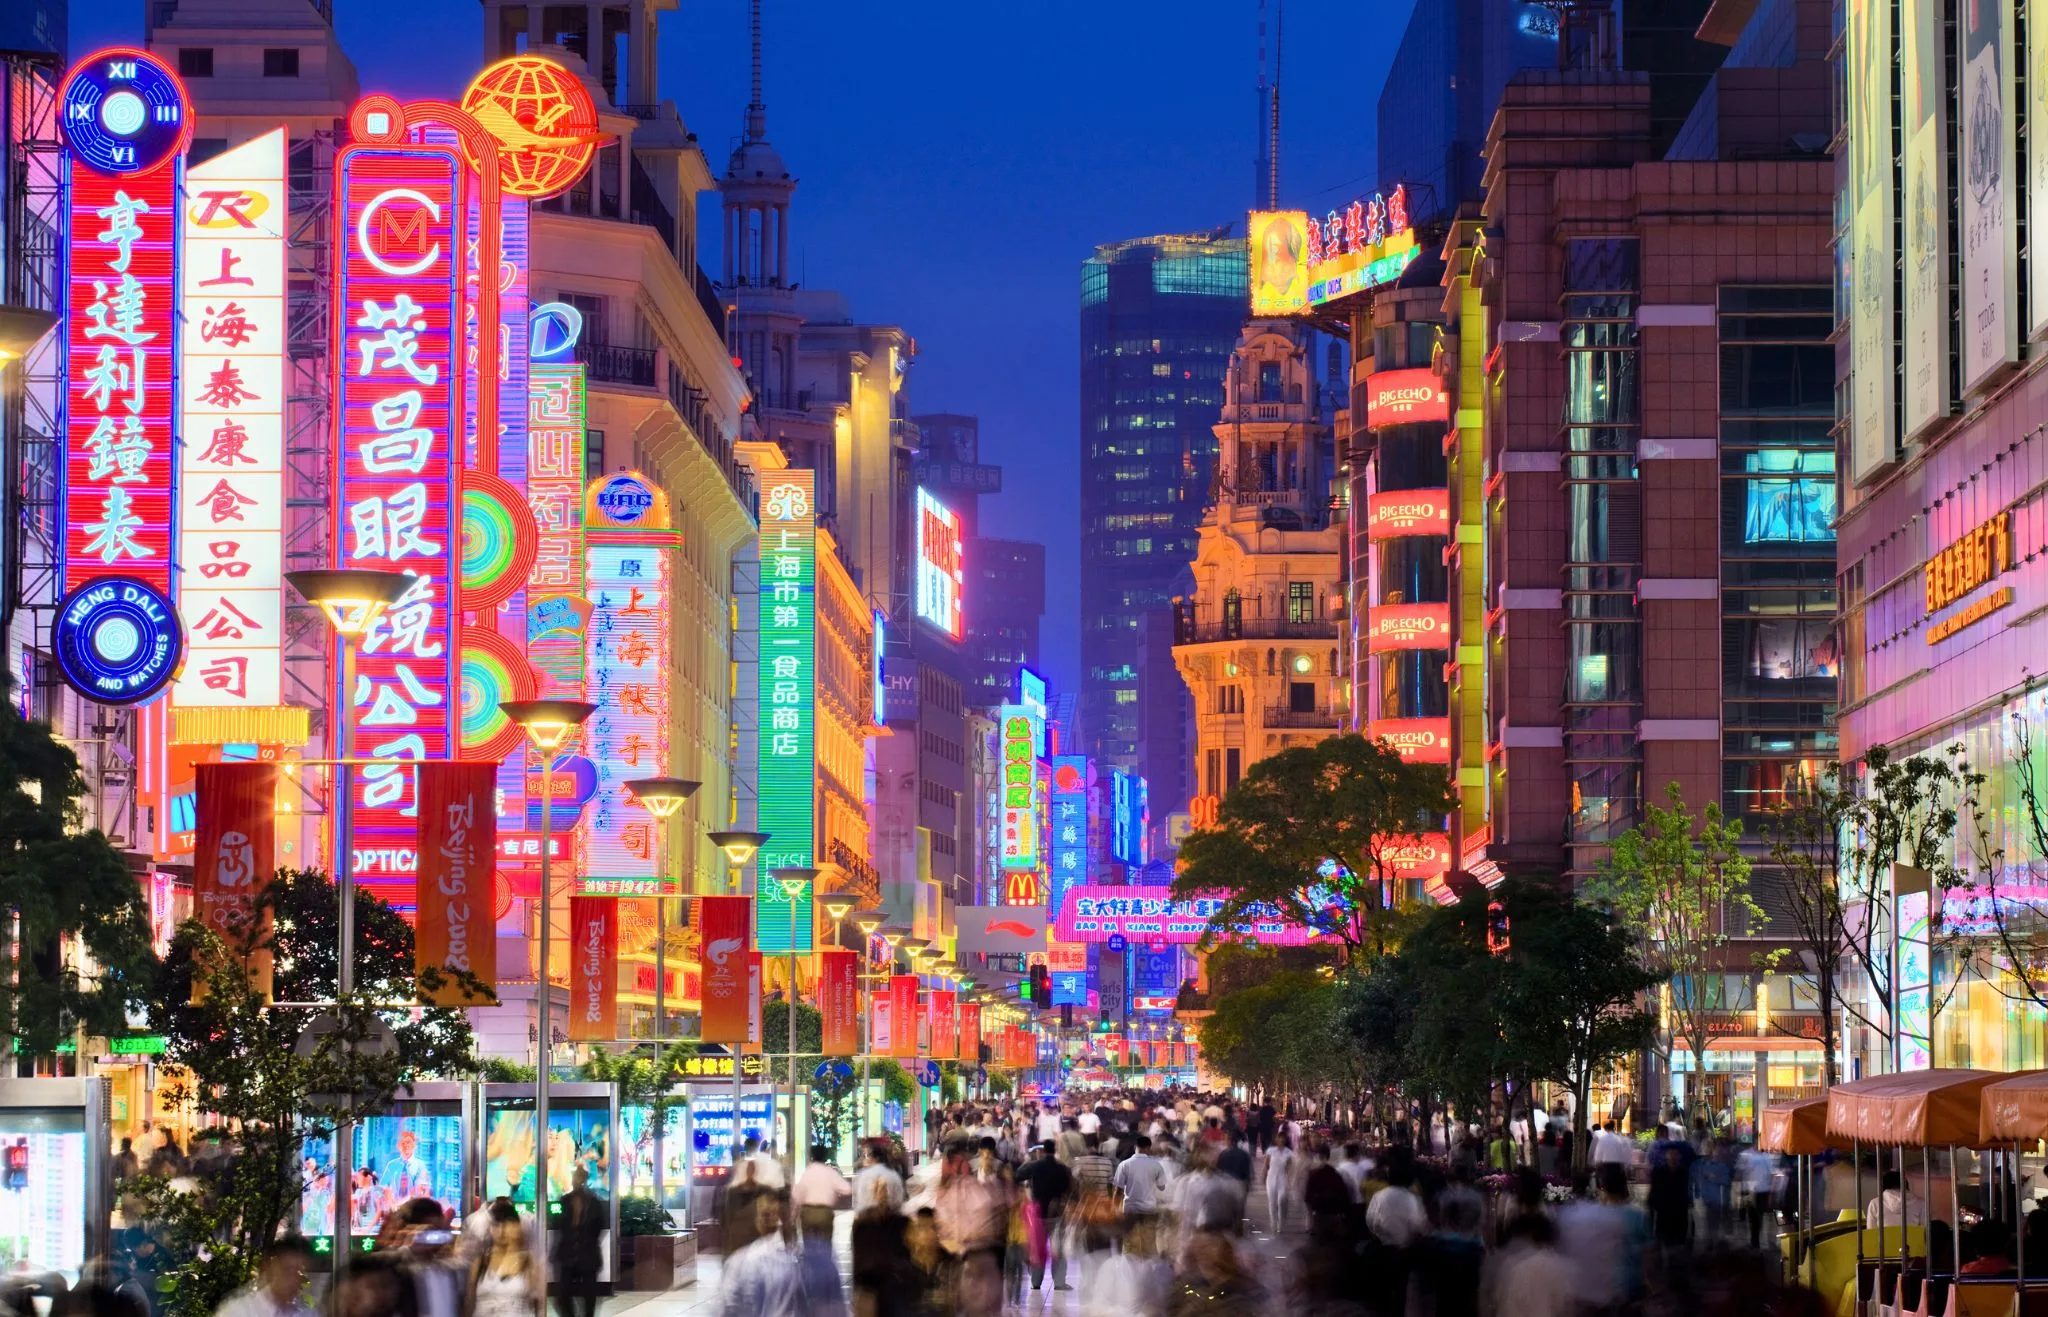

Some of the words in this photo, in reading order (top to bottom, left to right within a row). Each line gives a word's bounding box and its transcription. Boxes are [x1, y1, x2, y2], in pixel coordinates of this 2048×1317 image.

[109, 62, 136, 78] XII
[69, 104, 90, 120] IX
[157, 105, 178, 122] III
[112, 147, 134, 163] VI
[1379, 389, 1397, 406] BIG
[1397, 387, 1432, 401] ECHO
[192, 247, 263, 699] 上海泰康食品公司
[951, 465, 999, 488] 国家电网
[1379, 505, 1398, 520] BIG
[1398, 503, 1434, 517] ECHO
[619, 559, 643, 578] 原
[1925, 512, 2010, 613] 百联世茂国际广场
[67, 586, 116, 625] HENG
[123, 587, 166, 623] DALI
[1381, 618, 1399, 633] BIG
[1400, 616, 1436, 631] ECHO
[771, 529, 801, 756] 上海市第一食品商店
[96, 676, 123, 690] AND
[127, 633, 169, 687] WATCHES
[438, 792, 474, 896] Beijing
[1075, 922, 1097, 931] BAO
[1103, 922, 1118, 931] DA
[1126, 923, 1161, 932] XIANG
[1258, 924, 1284, 933] KIDS
[583, 914, 606, 977] Beijing
[586, 979, 603, 1024] 2008
[1102, 995, 1121, 1009] City
[1157, 999, 1172, 1008] KFC
[835, 1018, 843, 1044] Dream
[1708, 1023, 1743, 1033] ELATO
[114, 1038, 162, 1050] ROLEX
